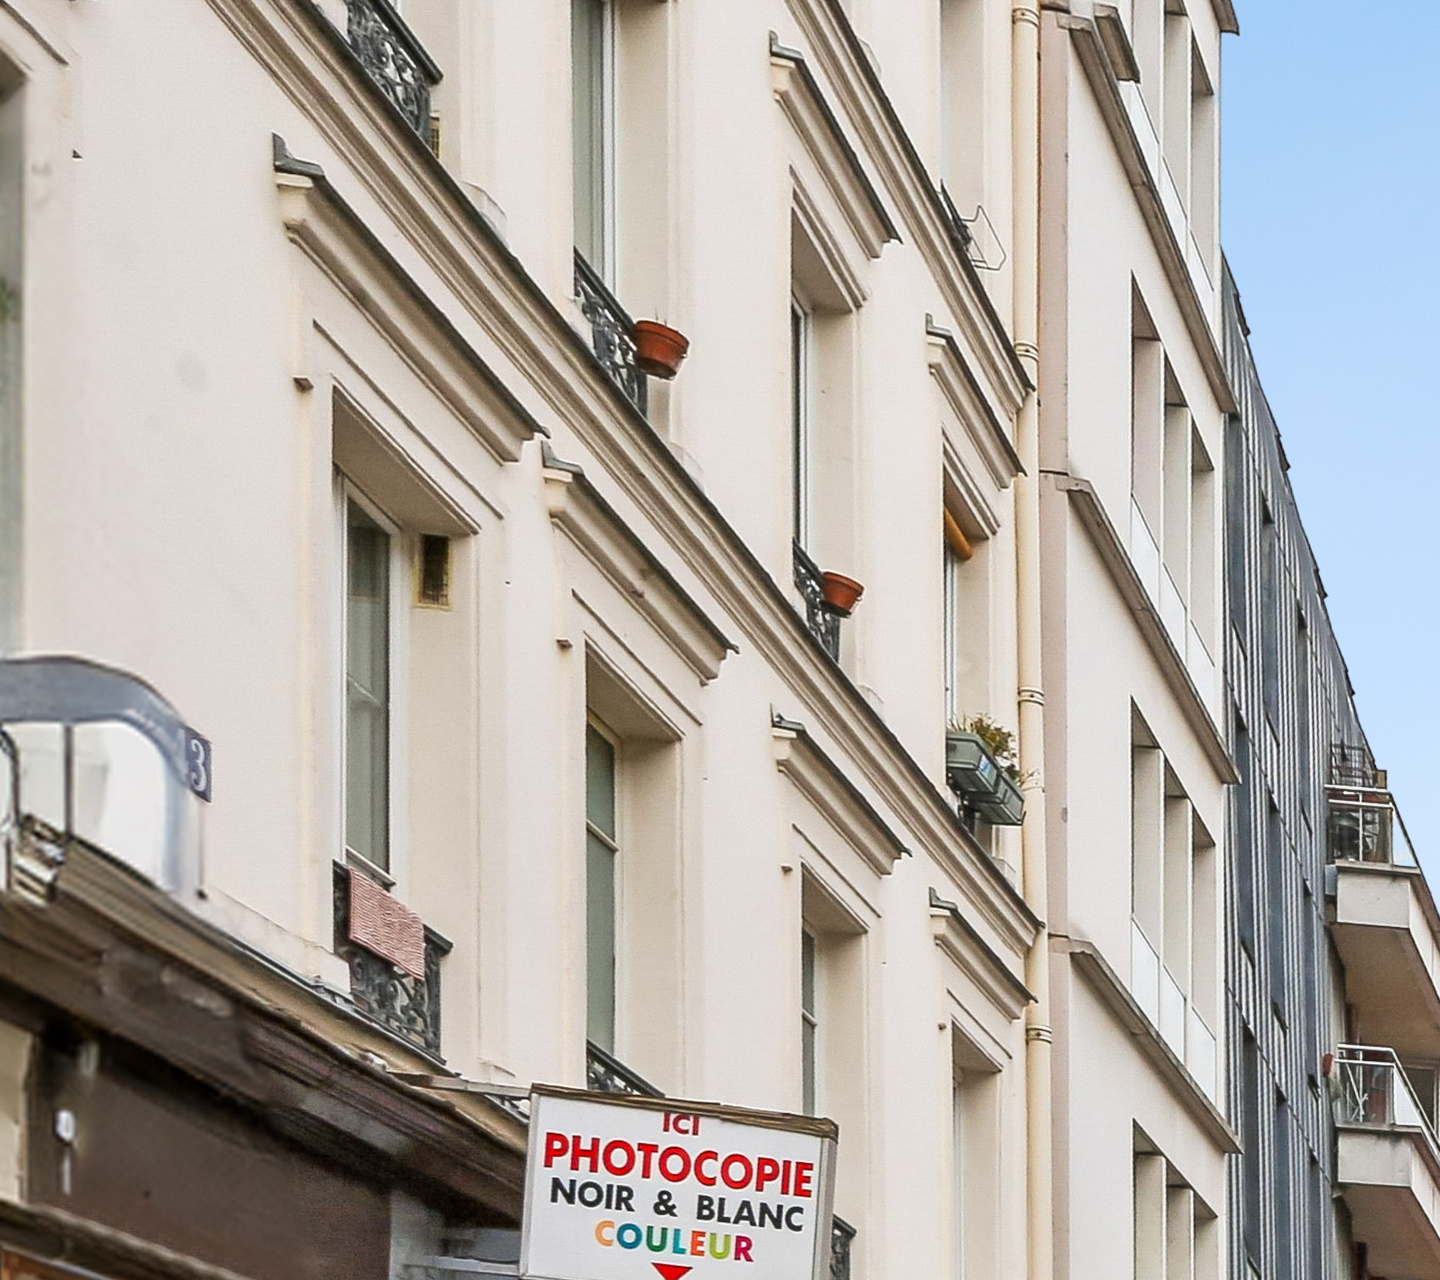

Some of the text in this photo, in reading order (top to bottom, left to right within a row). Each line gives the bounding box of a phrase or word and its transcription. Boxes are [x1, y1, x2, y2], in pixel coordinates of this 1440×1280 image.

[662, 1111, 700, 1136] ICI
[543, 1132, 814, 1198] PHOTOCOPIE
[550, 1177, 804, 1232] NOIR & BLANC
[595, 1220, 754, 1262] COULEUR
